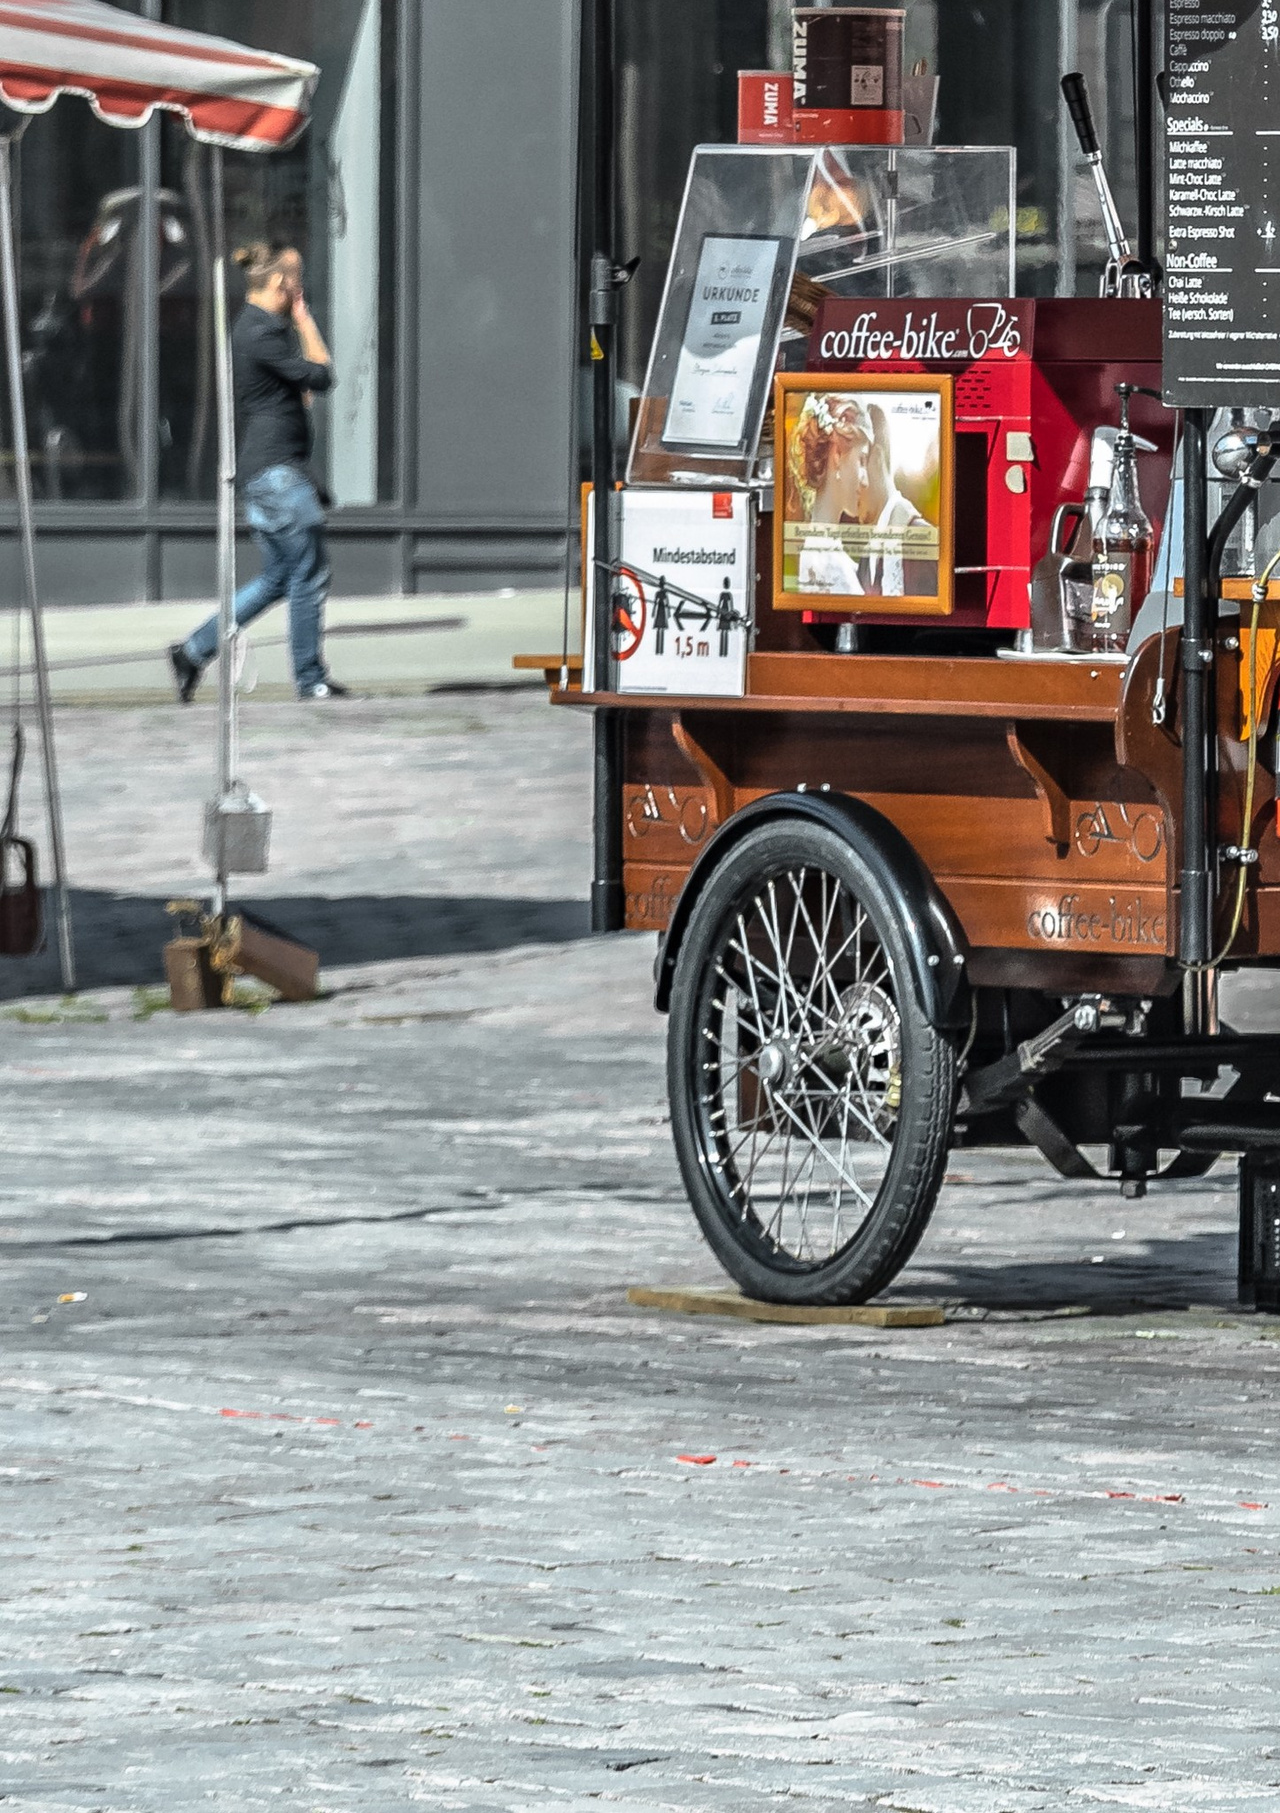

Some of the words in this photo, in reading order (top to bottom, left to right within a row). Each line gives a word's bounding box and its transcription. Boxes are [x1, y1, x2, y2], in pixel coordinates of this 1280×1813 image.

[1169, 12, 1200, 27] Espresso
[1200, 12, 1236, 24] macchiato
[1169, 28, 1200, 42] Espresso
[1200, 28, 1226, 42] doppio
[792, 21, 808, 100] ZUMA
[1169, 60, 1210, 74] Cappuccino
[763, 82, 779, 125] ZUMA
[1166, 116, 1204, 133] Specials
[1169, 141, 1208, 155] Milchkaffee
[1169, 157, 1187, 170] Latte
[1187, 157, 1223, 170] macchiato
[1169, 173, 1203, 185] Mint-Choc
[1204, 173, 1222, 186] Latte
[1169, 189, 1217, 202] Karamell-Choc
[1218, 189, 1236, 202] Latte
[1226, 205, 1245, 218] Latte
[1169, 226, 1187, 238] Extra
[1187, 226, 1218, 240] Espresso
[1218, 225, 1235, 238] Shot
[1166, 253, 1218, 269] Non-Coffee
[1168, 275, 1185, 289] Chai
[1185, 276, 1203, 289] Latte
[702, 286, 760, 303] URKUNDE
[1189, 291, 1228, 305] Schokolade
[1168, 307, 1181, 320] Tee
[820, 311, 956, 360] coffee-bike
[652, 547, 737, 566] Mindestabstand
[674, 636, 694, 659] 1,5
[696, 641, 710, 657] m
